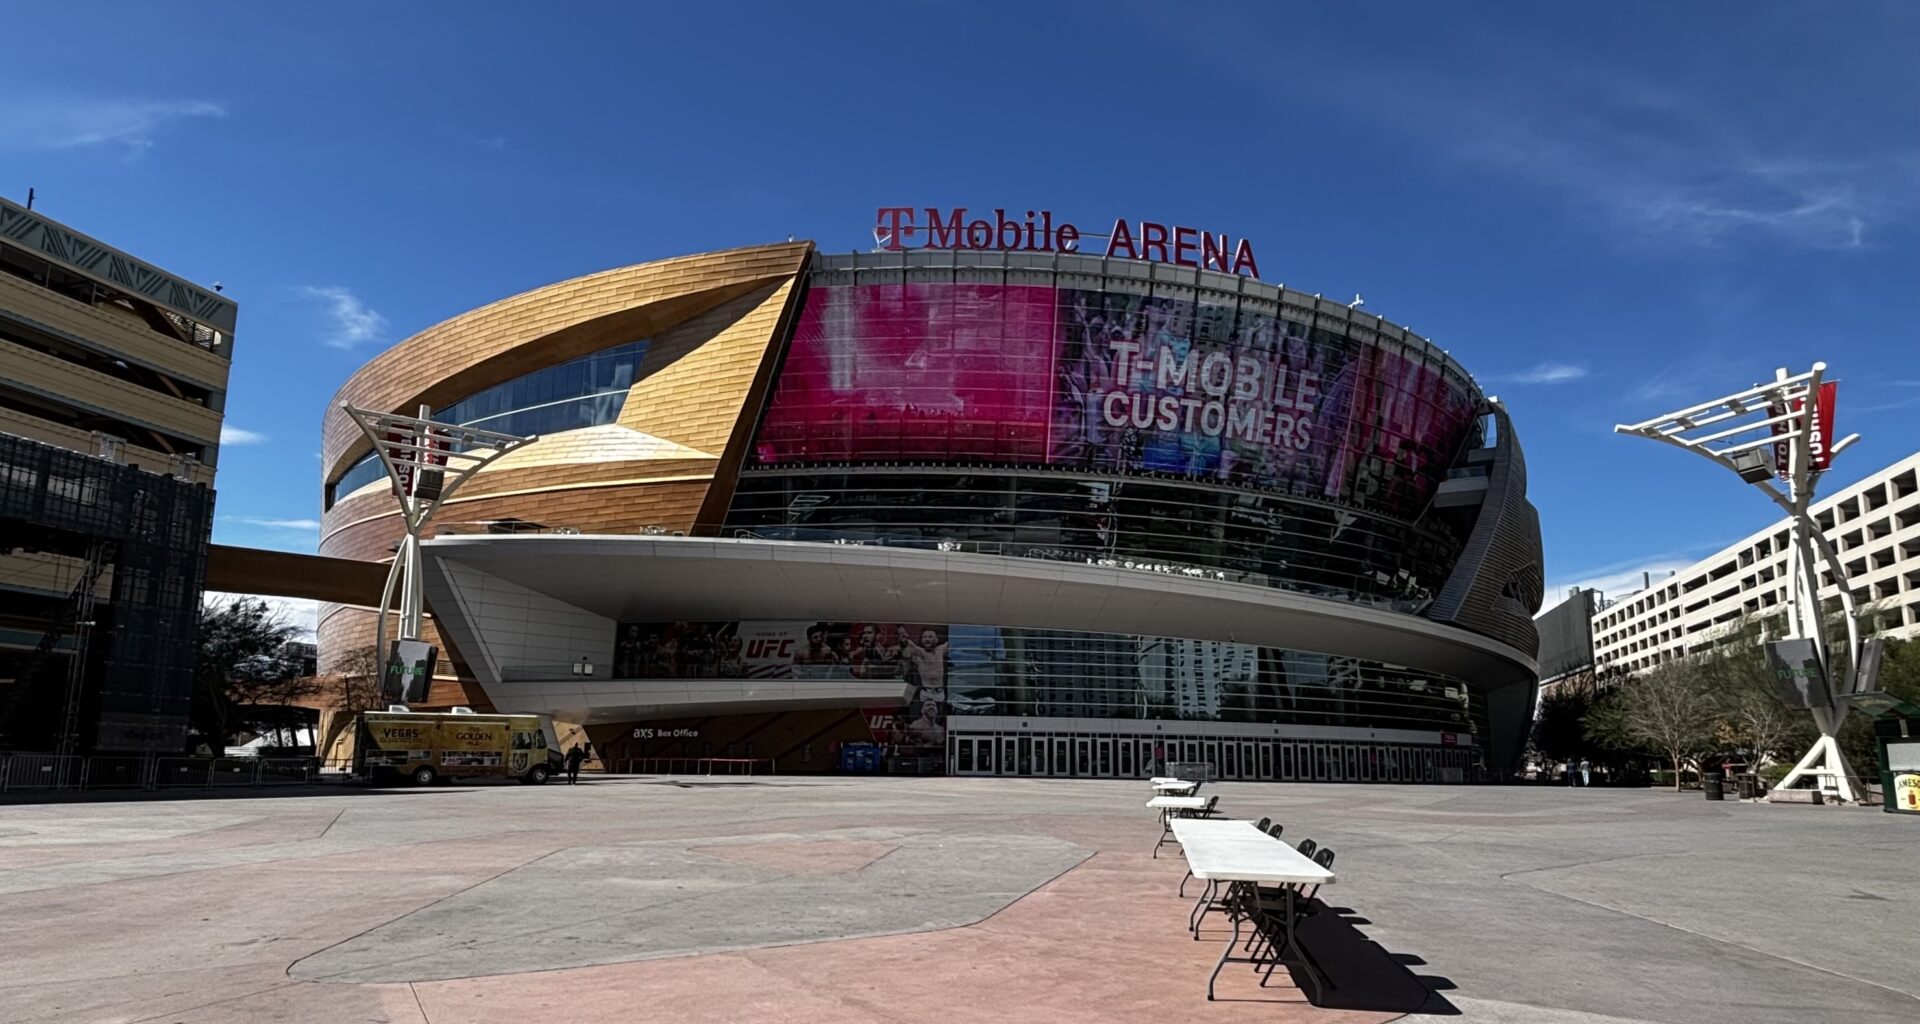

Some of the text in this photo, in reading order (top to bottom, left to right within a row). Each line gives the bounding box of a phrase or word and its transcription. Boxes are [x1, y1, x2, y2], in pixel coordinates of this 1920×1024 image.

[923, 208, 1080, 253] Mobile
[1105, 218, 1260, 279] ARENA
[1110, 340, 1318, 412] T-MOBILE
[1103, 391, 1313, 450] CUSTOMERS
[746, 639, 796, 658] UFC
[390, 665, 425, 676] FUTURE
[1777, 667, 1818, 679] FUTURE
[383, 728, 419, 738] VEGAS
[456, 732, 492, 741] GOLDEN
[633, 728, 699, 740] axs Box Office
